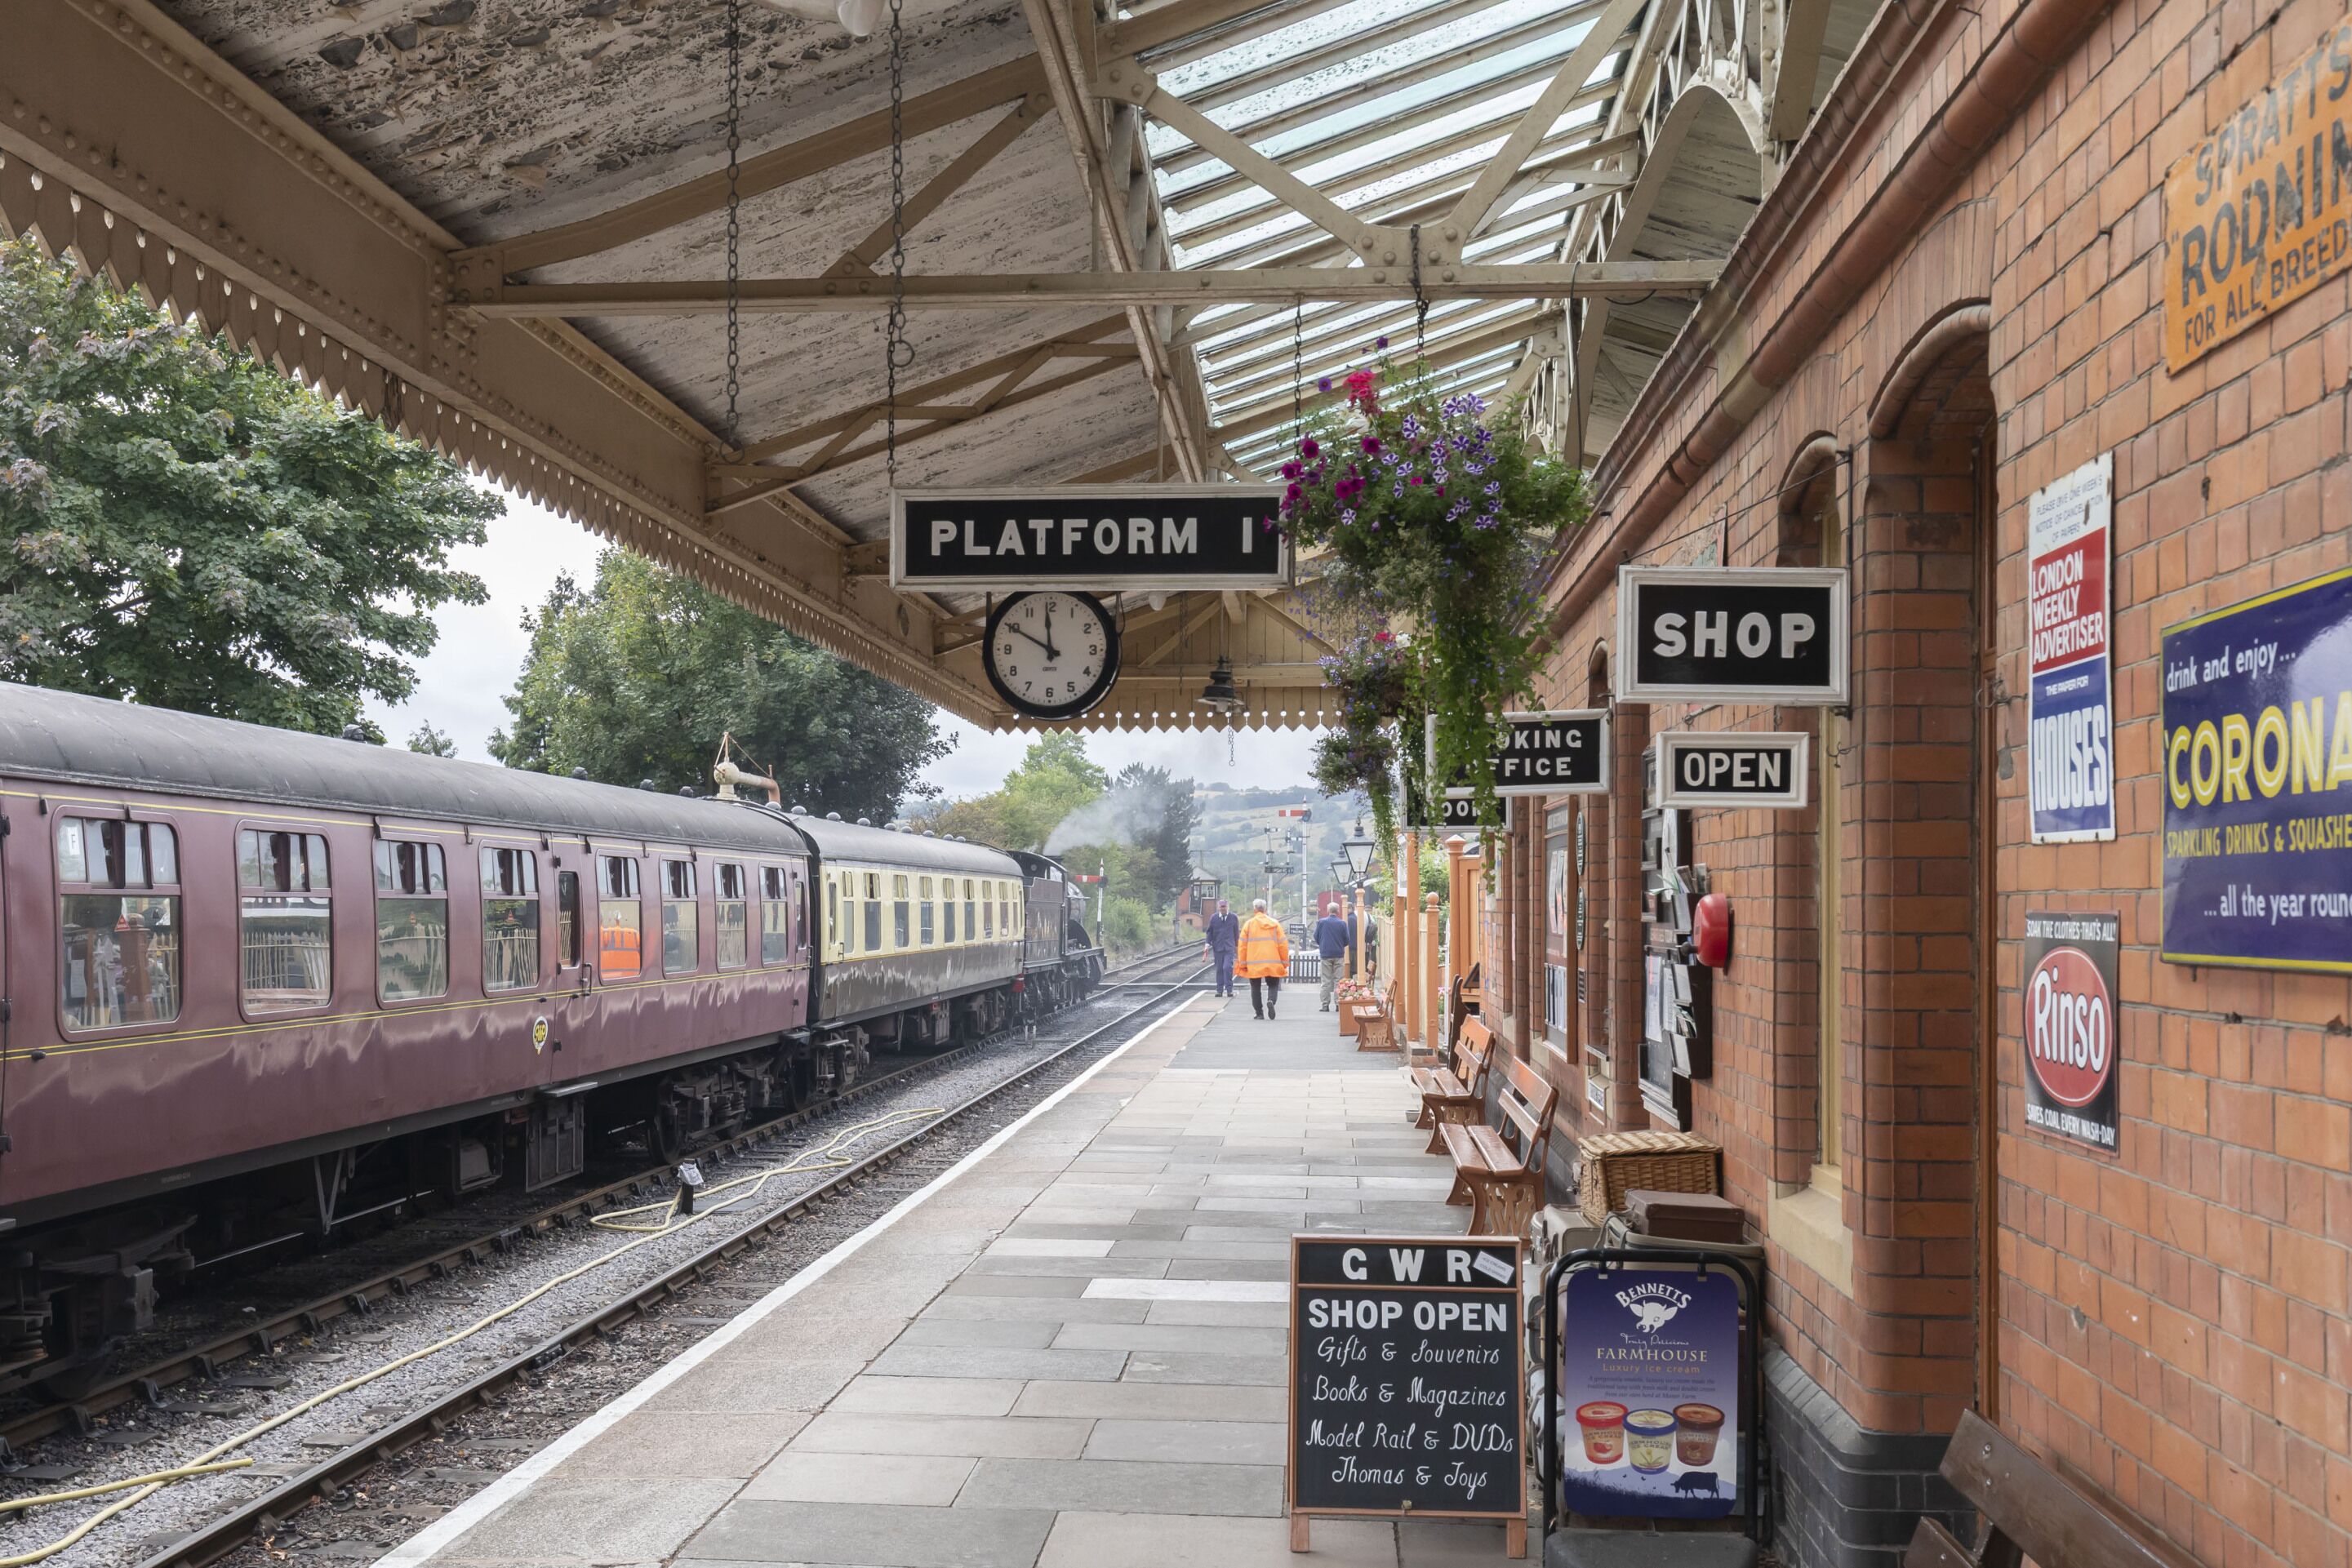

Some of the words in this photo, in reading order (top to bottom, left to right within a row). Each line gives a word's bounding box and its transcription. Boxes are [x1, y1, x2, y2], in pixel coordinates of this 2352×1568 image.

[2185, 304, 2216, 353] FOR
[2225, 275, 2261, 329] ALL
[2270, 217, 2352, 300] BREED
[931, 517, 1198, 557] PLATFORM
[2032, 549, 2083, 599] LONDON
[2034, 584, 2080, 631] WEEKLY
[1083, 624, 1092, 634] 2
[1653, 611, 1815, 659] SHOP
[2034, 611, 2104, 664] ADVERTISER
[1004, 644, 1012, 655] 9
[1089, 644, 1097, 655] 3
[1009, 665, 1017, 677] 8
[1083, 666, 1092, 677] 4
[2167, 656, 2197, 693] drink
[2203, 645, 2230, 682] and
[1025, 681, 1033, 691] 7
[1046, 687, 1054, 698] 6
[1067, 682, 1075, 692] 5
[2046, 685, 2057, 696] THE
[2077, 675, 2089, 689] FOR
[1469, 729, 1582, 748] OKING
[1474, 757, 1572, 776] FFICE
[1683, 752, 1781, 788] OPEN
[2034, 704, 2107, 811] HOUSES
[2167, 827, 2220, 859] SPARKLING
[2226, 822, 2269, 855] DRINKS
[2274, 826, 2284, 852] &
[2242, 885, 2265, 917] the
[2270, 893, 2305, 926] year
[2310, 893, 2352, 917] roun
[2043, 921, 2053, 939] THE
[2034, 966, 2105, 1073] Rinso
[2044, 1108, 2060, 1130] COAL
[2061, 1113, 2080, 1136] EVERY
[1615, 1282, 1692, 1308] BENNETTS
[1308, 1299, 1403, 1330] SHOP
[1413, 1301, 1507, 1332] OPEN
[1318, 1335, 1367, 1367] Gifts
[1381, 1342, 1397, 1361] &
[1412, 1339, 1500, 1364] Souvenirs
[1597, 1348, 1708, 1362] FARMHOUSE
[1313, 1375, 1368, 1402] Books
[1379, 1383, 1395, 1403] &
[1407, 1376, 1505, 1418] Magazines
[1306, 1419, 1365, 1448] Model
[1373, 1422, 1416, 1450] Rail
[1424, 1430, 1440, 1450] &
[1449, 1422, 1513, 1453] DVDs
[1332, 1455, 1405, 1485] Thomas
[1416, 1466, 1432, 1486] &
[1444, 1462, 1488, 1500] Toys
